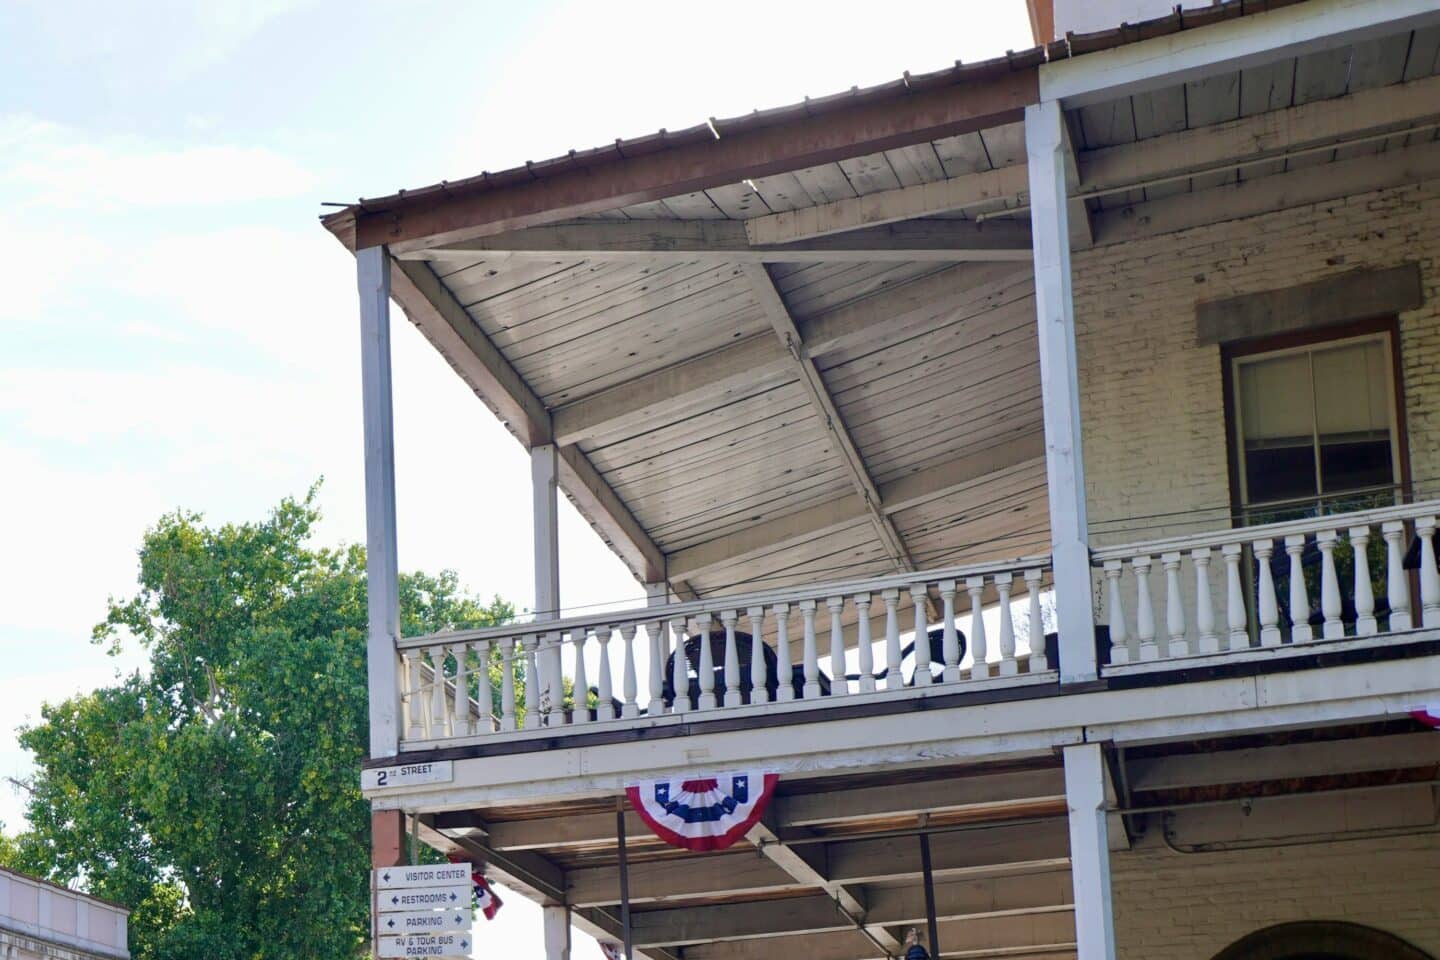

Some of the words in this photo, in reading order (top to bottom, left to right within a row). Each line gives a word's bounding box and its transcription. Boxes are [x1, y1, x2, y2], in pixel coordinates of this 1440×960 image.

[400, 764, 432, 776] STREET
[405, 871, 434, 881] VISITOR
[436, 870, 466, 880] CENTER
[402, 894, 447, 904] RESTROOMS
[406, 917, 442, 927] PARKING
[396, 938, 406, 946] RV
[416, 937, 436, 945] TOUR
[438, 936, 454, 944] BUS
[406, 946, 442, 955] PARKING
